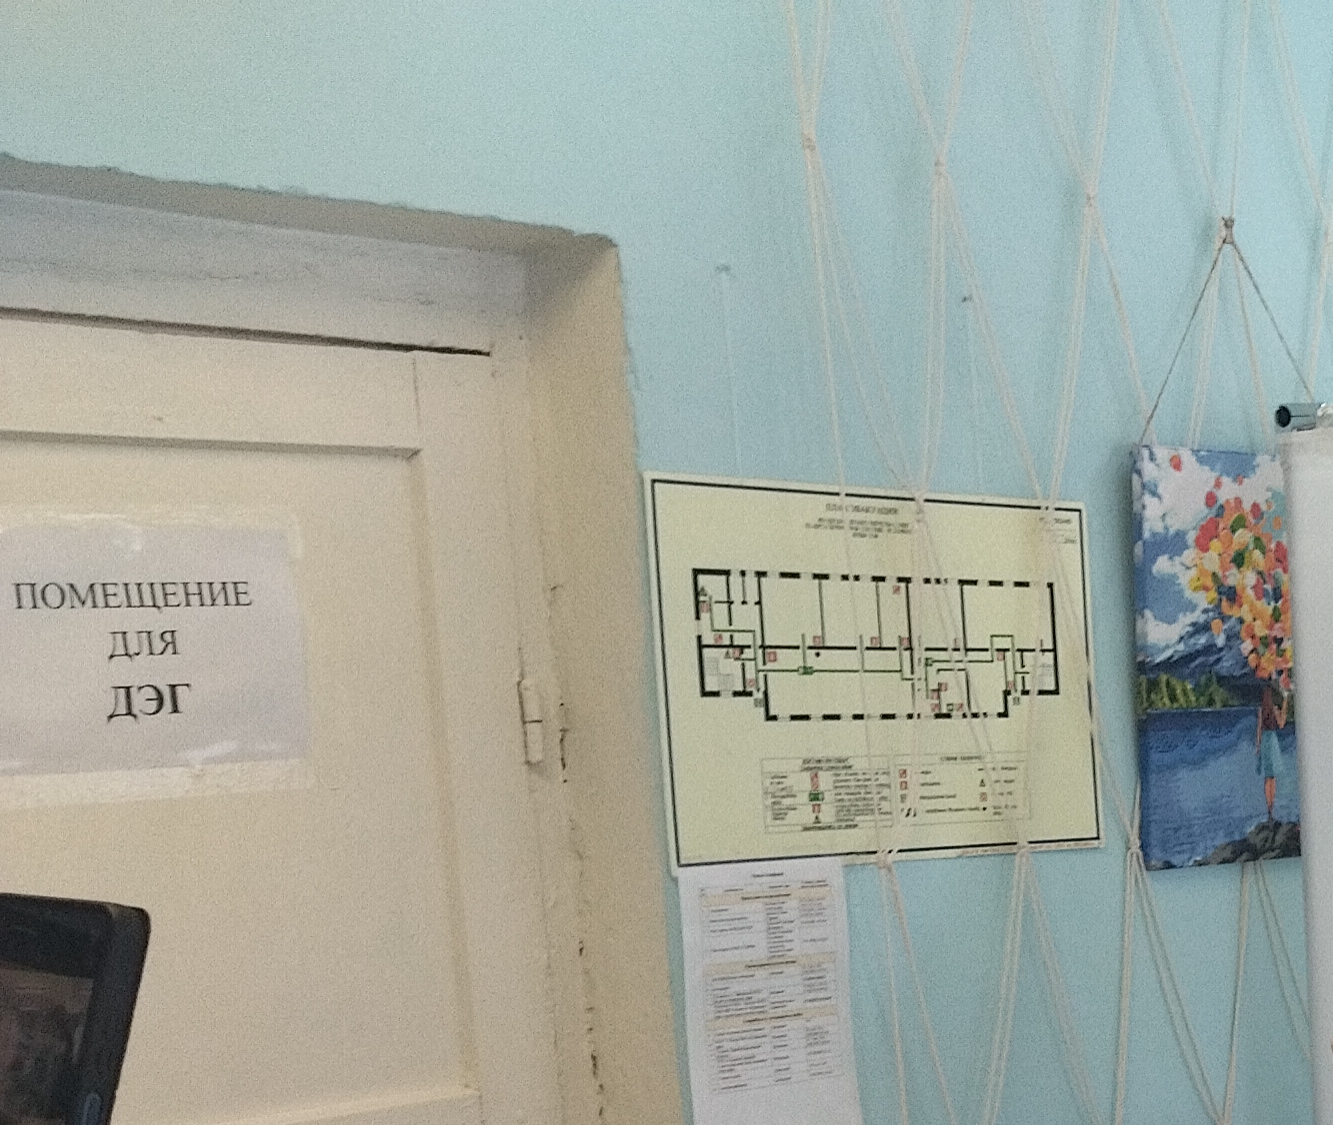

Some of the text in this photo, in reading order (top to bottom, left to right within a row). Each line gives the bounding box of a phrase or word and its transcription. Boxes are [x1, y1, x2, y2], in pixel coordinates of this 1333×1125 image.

[11, 581, 252, 613] ПОМЕЩЕНИЕ
[108, 630, 181, 661] ДЛЯ
[107, 683, 192, 724] ДЭГ
